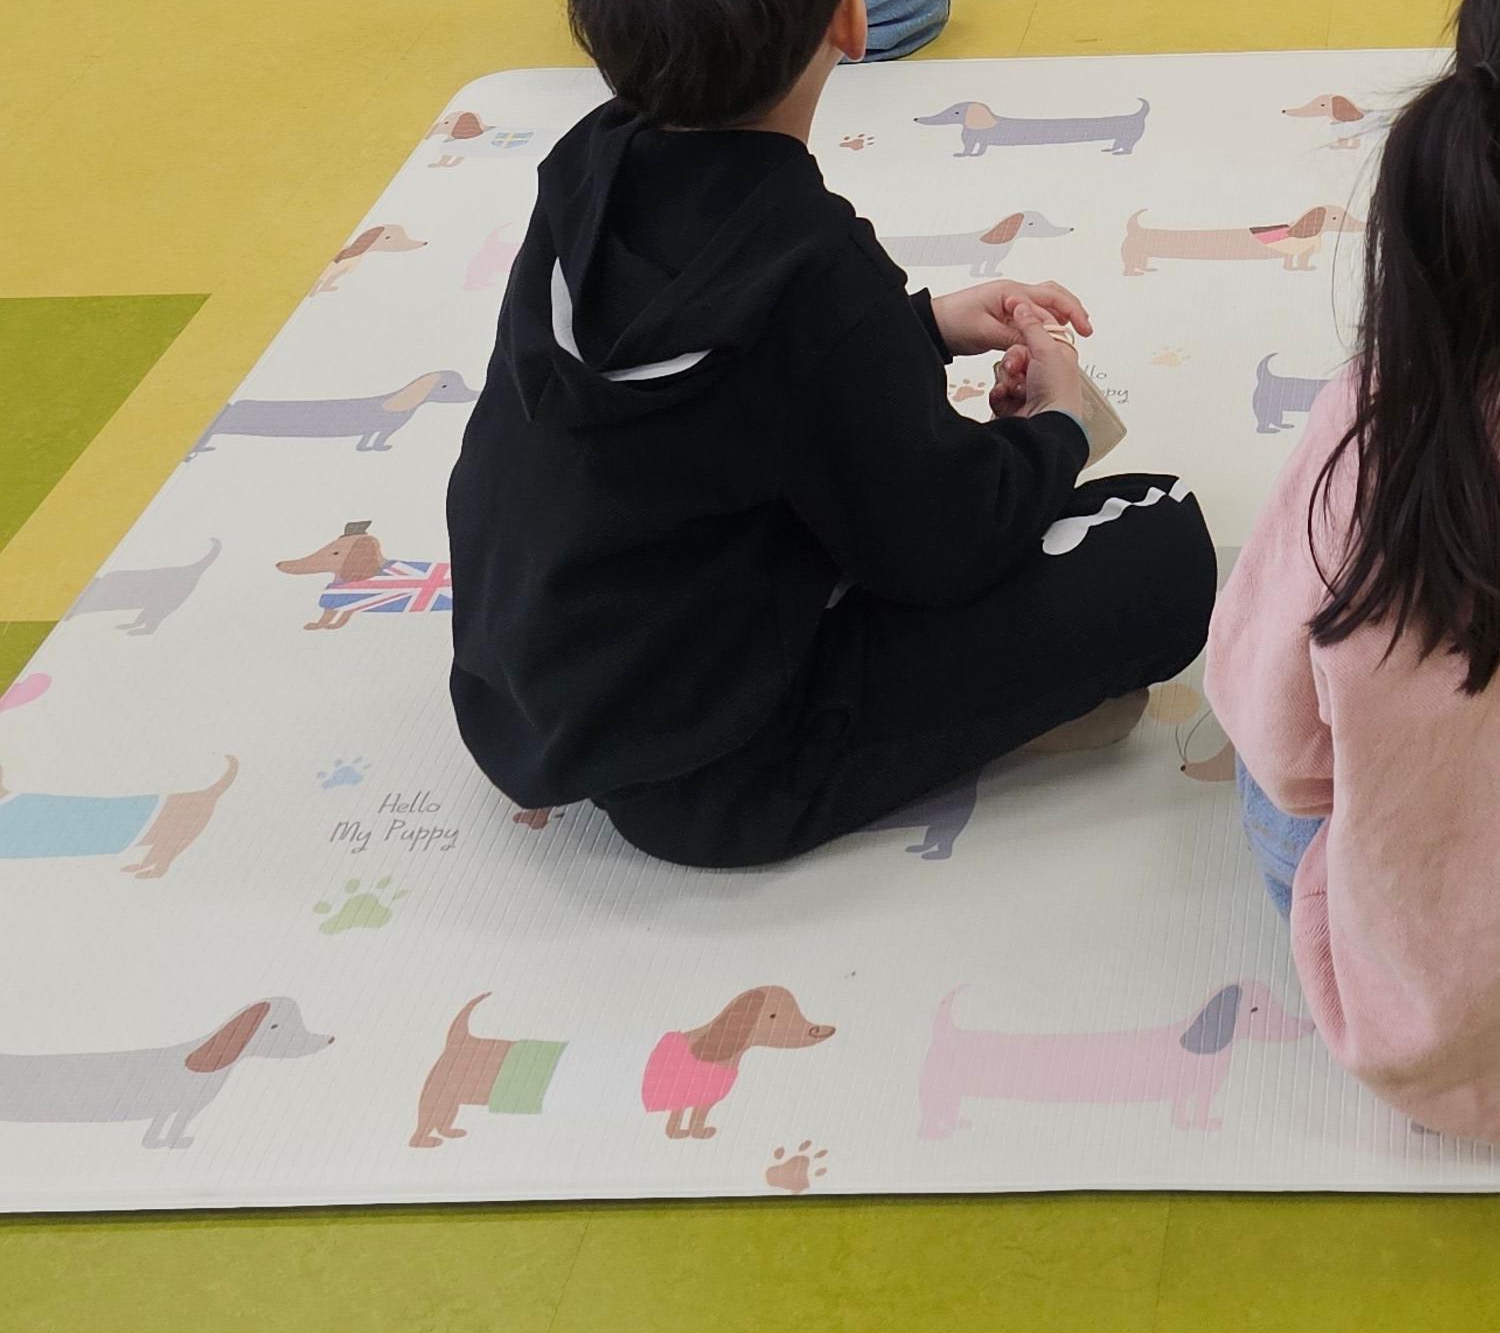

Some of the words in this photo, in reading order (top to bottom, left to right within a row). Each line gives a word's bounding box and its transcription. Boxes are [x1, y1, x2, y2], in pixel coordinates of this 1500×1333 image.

[377, 790, 441, 814] Hello
[330, 820, 372, 854] My
[383, 819, 459, 852] Puppy
